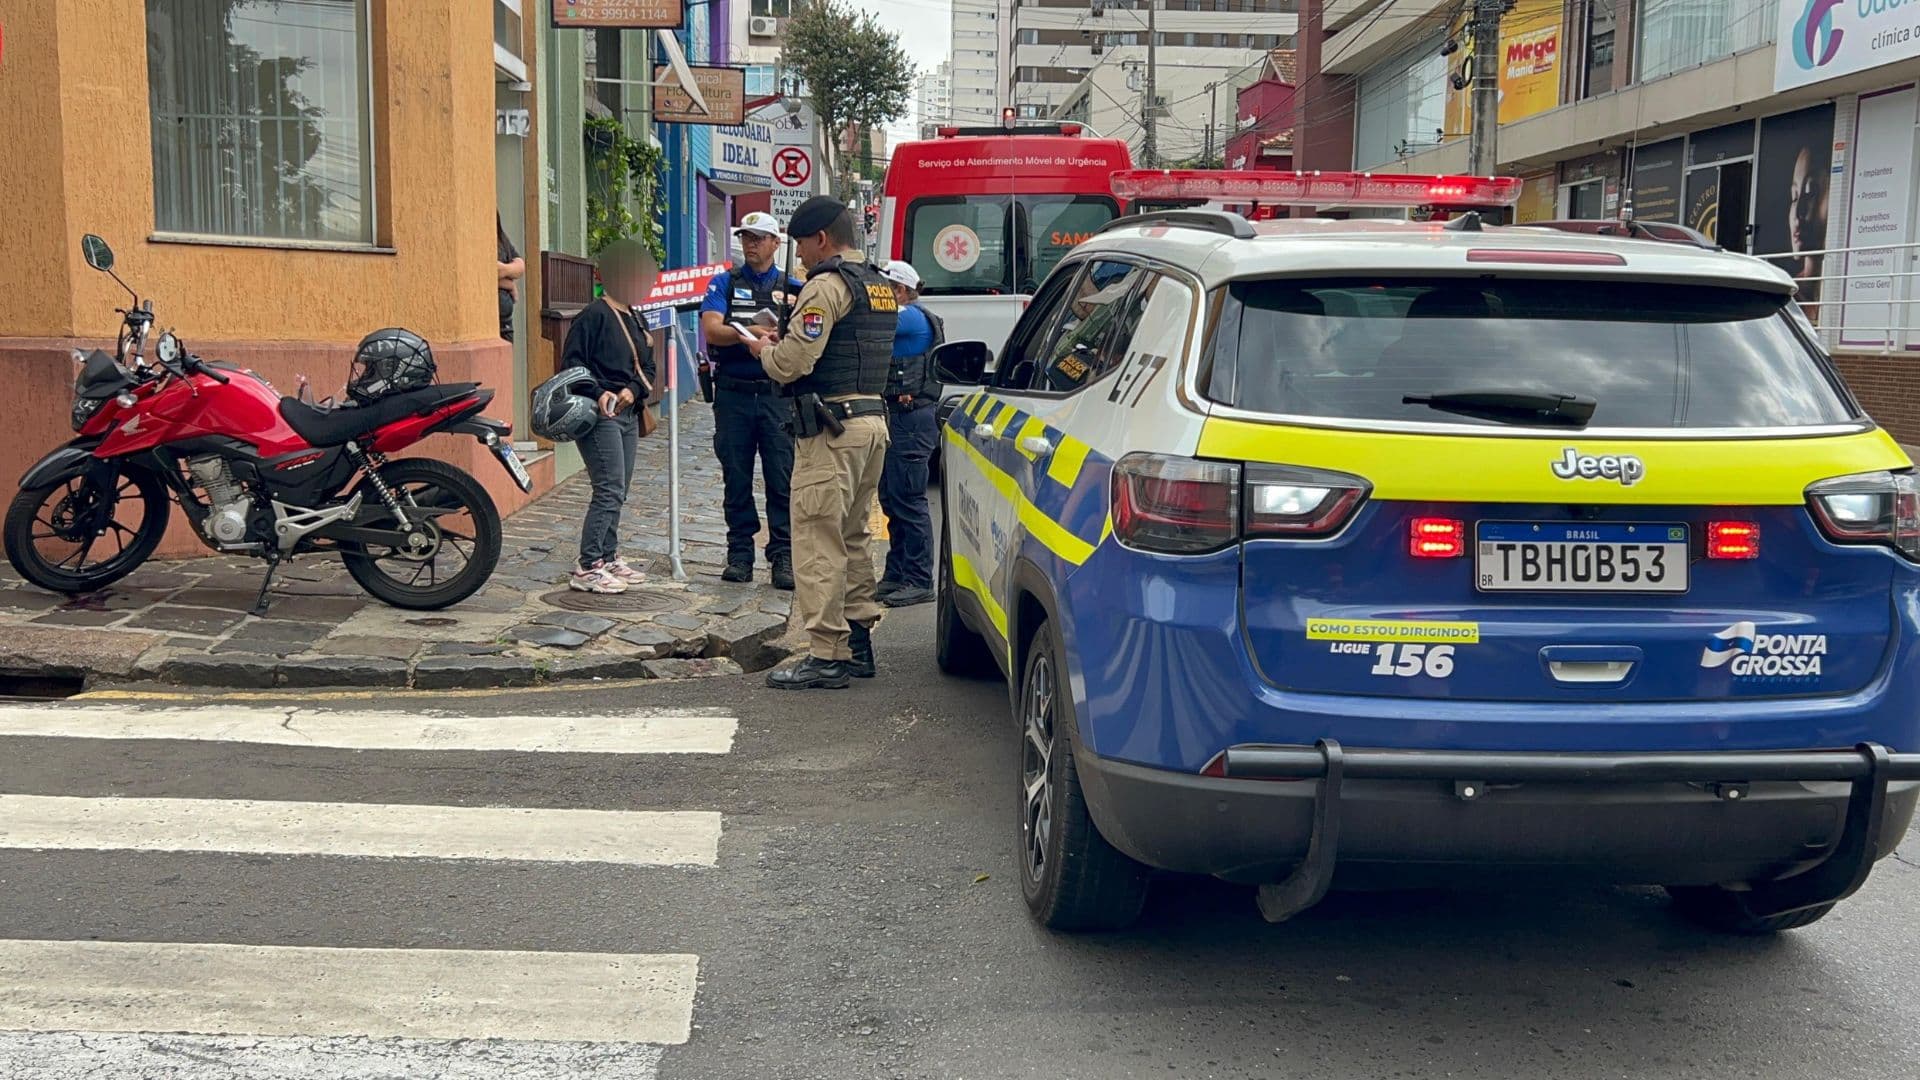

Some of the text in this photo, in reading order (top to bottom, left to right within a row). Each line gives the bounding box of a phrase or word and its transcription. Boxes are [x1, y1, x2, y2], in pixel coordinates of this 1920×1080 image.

[601, 8, 668, 19] 99914-1144
[1871, 26, 1910, 50] clínica
[1507, 34, 1556, 65] Mega
[722, 142, 759, 168] IDEAL
[918, 155, 1108, 169] Serviço de Atendimento Móvel de Urgência
[1863, 166, 1893, 178] Implantes
[770, 188, 812, 198] DIAS ÚTEIS
[1051, 231, 1094, 246] SAM
[661, 264, 725, 283] MARCA
[649, 282, 695, 297] AQUI
[866, 283, 895, 298] POLÍCIA
[869, 297, 898, 312] MILITAR
[1552, 448, 1644, 485] Jeep
[1566, 530, 1600, 540] BRASIL
[1481, 574, 1494, 587] BR
[1310, 623, 1477, 638] COMO ESTOU DIRIGINDO?
[1752, 634, 1827, 655] PONTA
[1330, 643, 1455, 678] LIGUE 156
[1731, 655, 1821, 676] GROSSA
